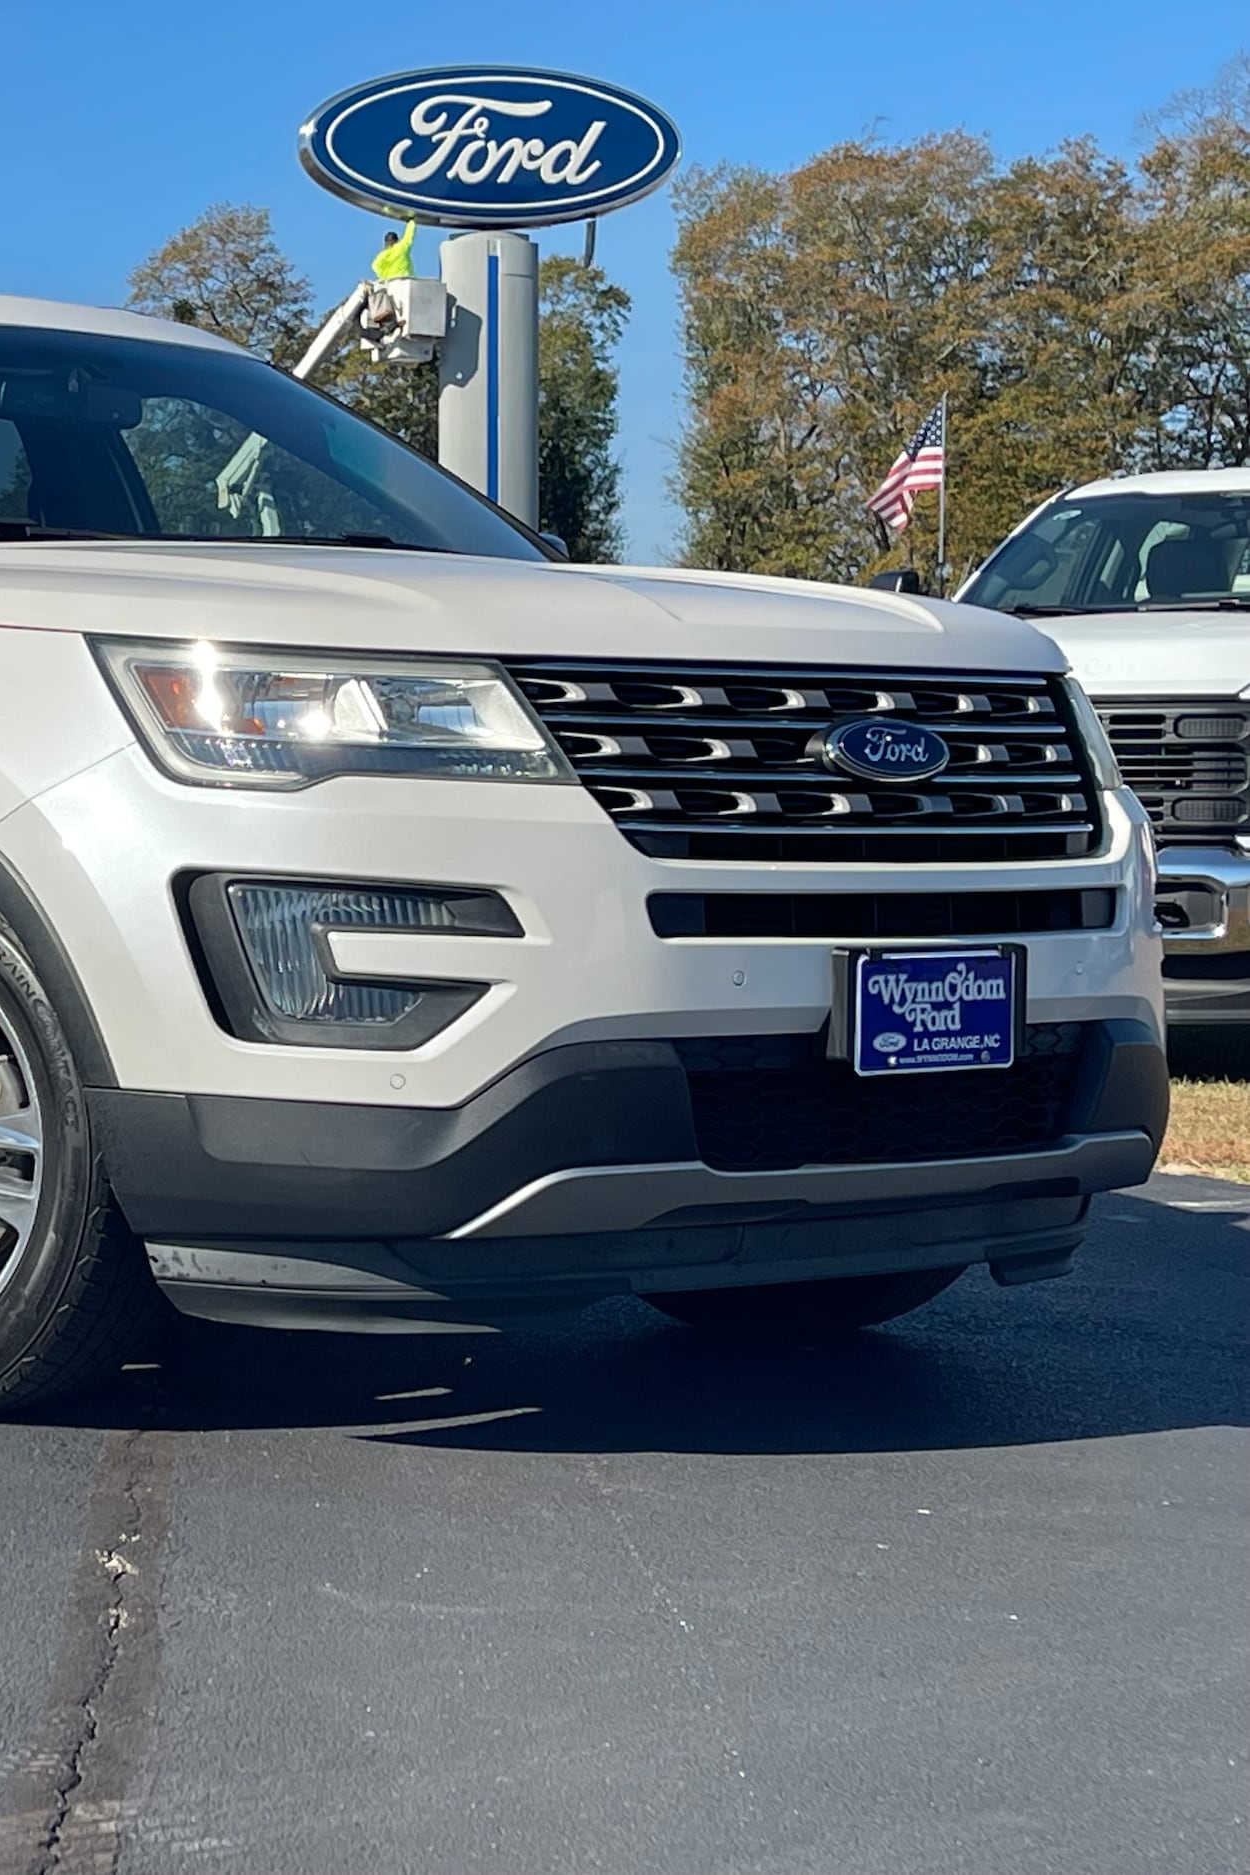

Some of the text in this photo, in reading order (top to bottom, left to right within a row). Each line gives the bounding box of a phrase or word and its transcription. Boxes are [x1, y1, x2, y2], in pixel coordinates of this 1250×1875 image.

[388, 94, 607, 185] Ford
[864, 726, 930, 763] Ford
[905, 1002, 961, 1033] Ford
[913, 1037, 931, 1052] LA
